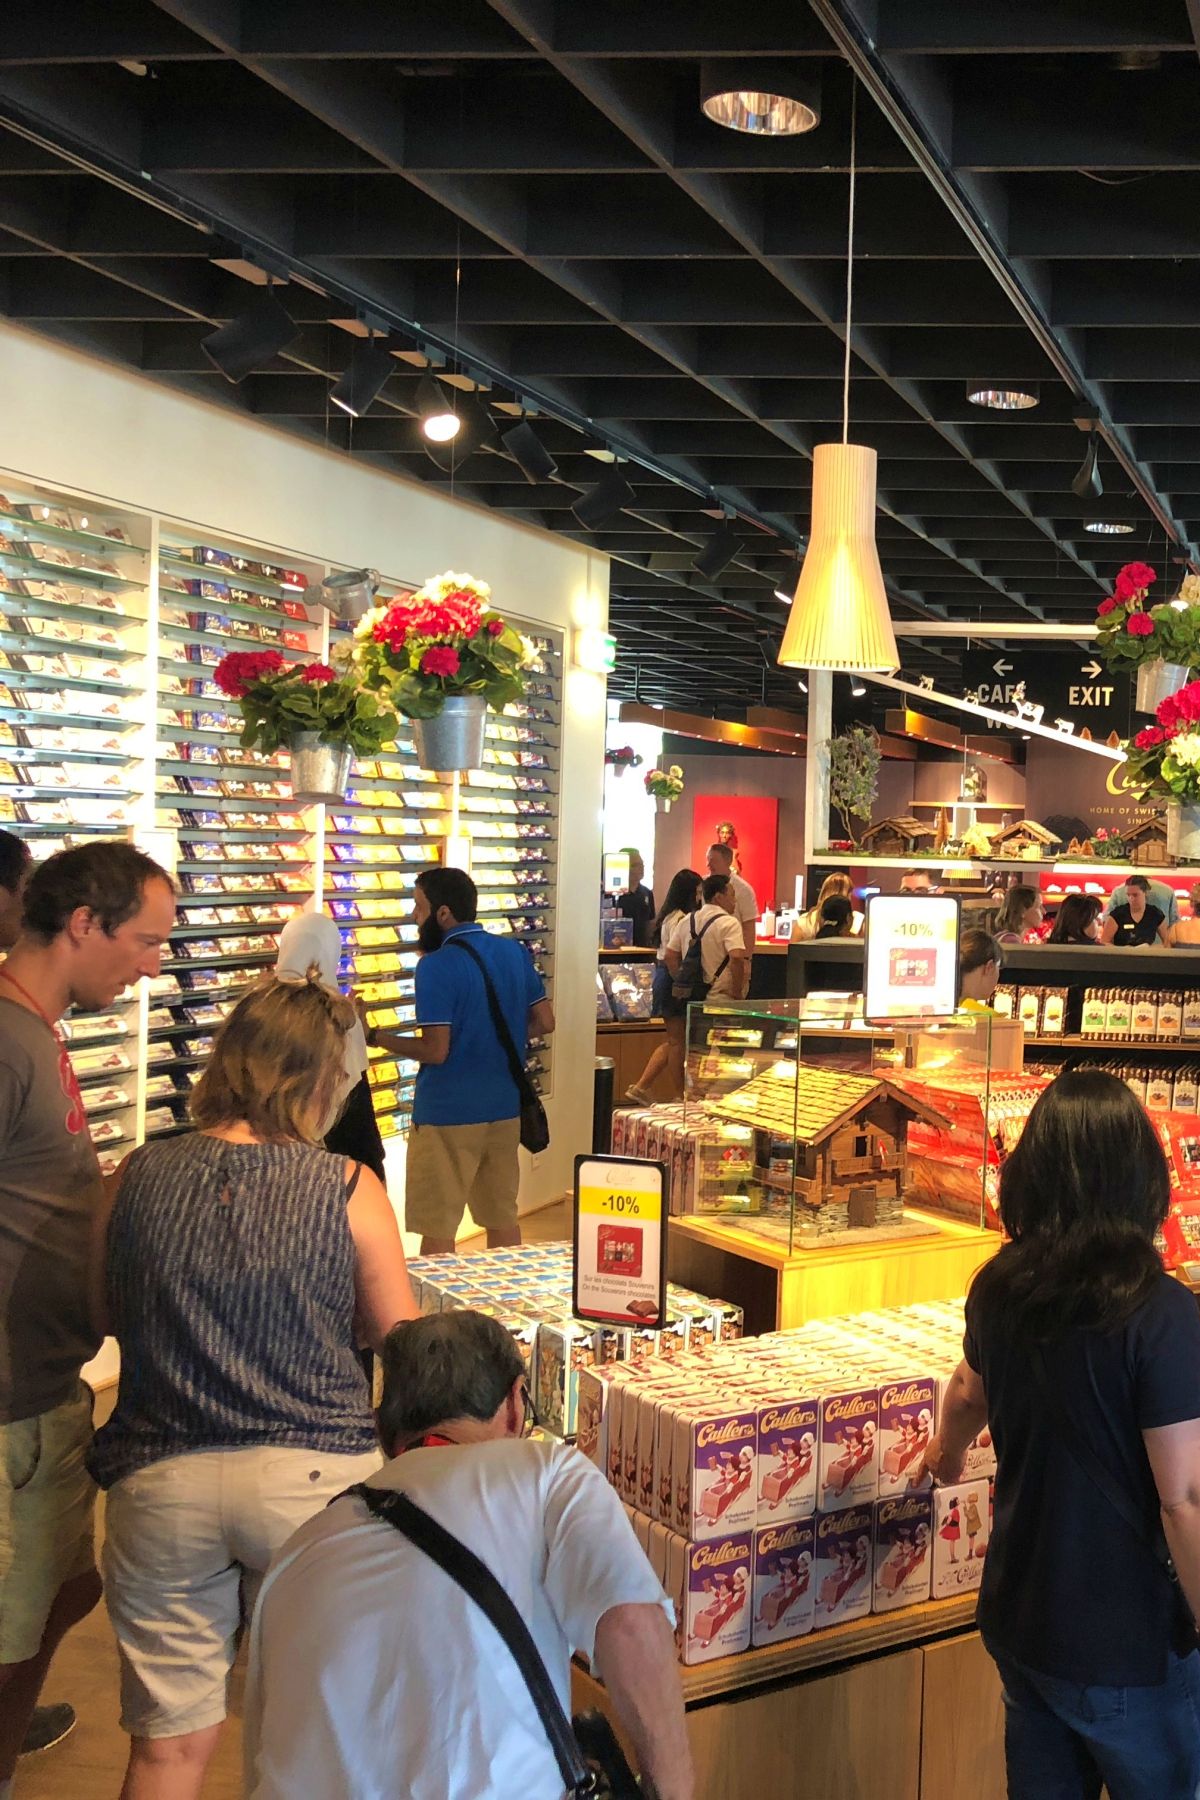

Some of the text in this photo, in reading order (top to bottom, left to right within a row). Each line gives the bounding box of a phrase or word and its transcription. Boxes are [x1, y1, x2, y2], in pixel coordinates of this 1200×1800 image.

[977, 683, 1114, 706] CAF EXIT
[1089, 807, 1115, 815] HOME
[1118, 807, 1130, 815] OF
[894, 922, 934, 937] -10%
[601, 1194, 640, 1214] -10%
